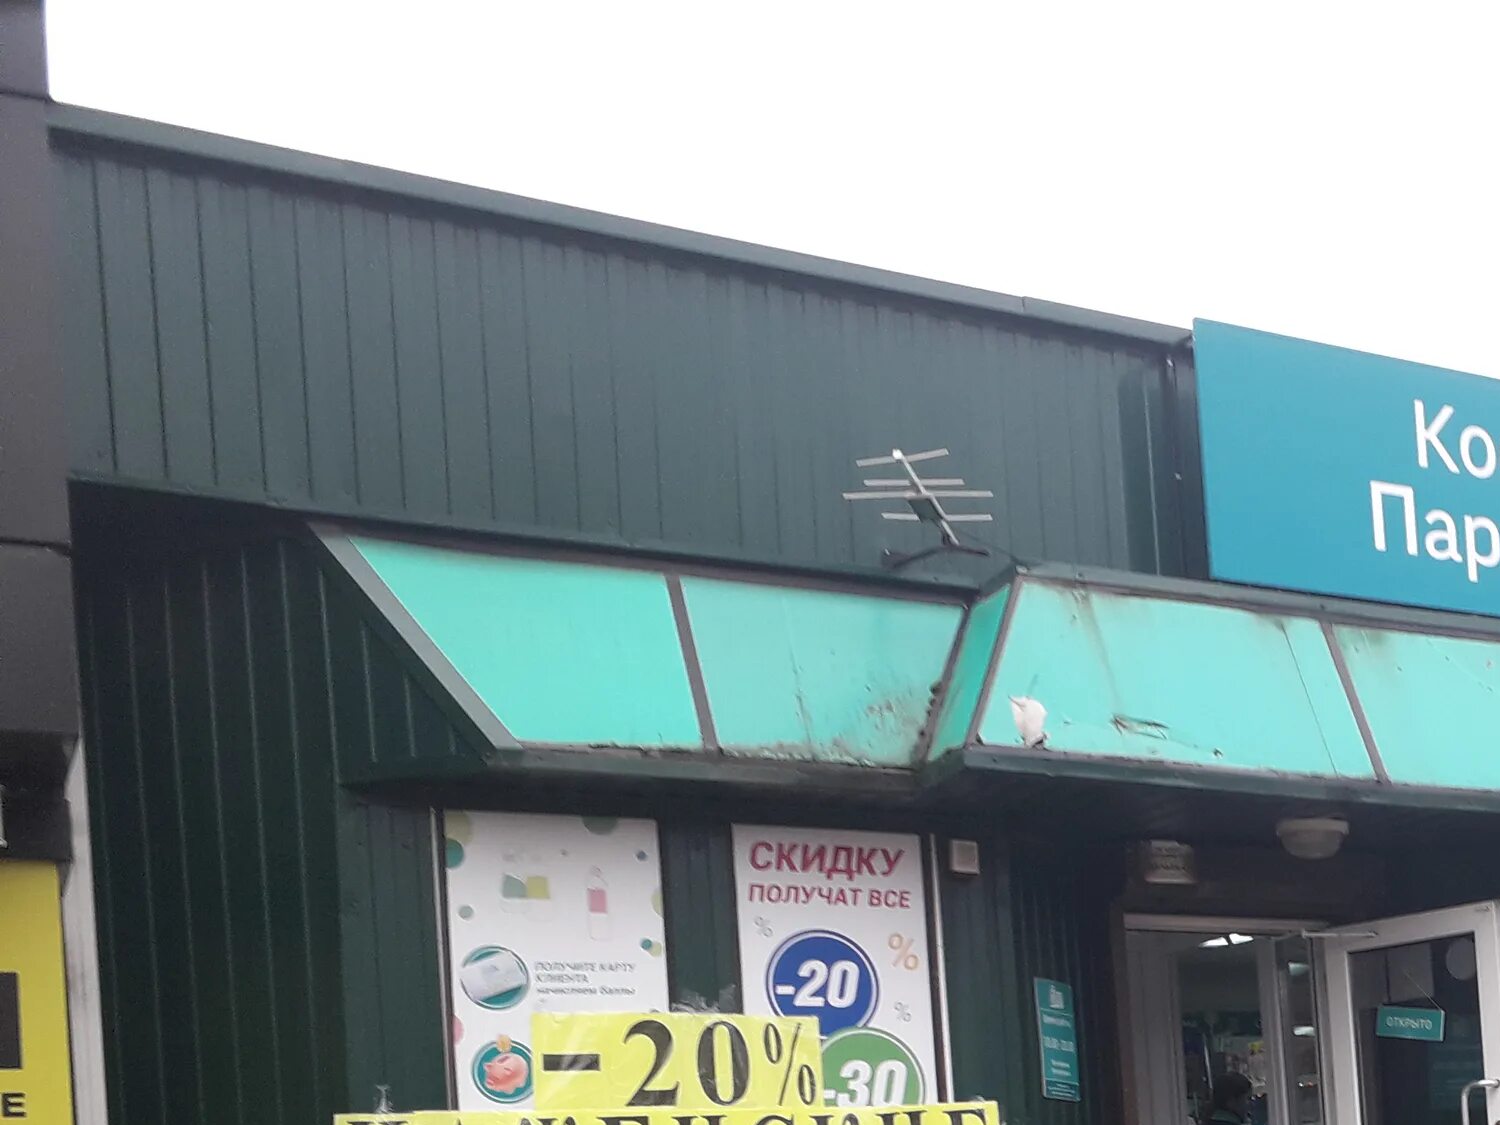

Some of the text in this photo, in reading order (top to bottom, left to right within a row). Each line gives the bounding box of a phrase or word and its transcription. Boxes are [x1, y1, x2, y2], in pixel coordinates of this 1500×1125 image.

[749, 841, 905, 882] СКИДКУ
[749, 884, 911, 909] ПОЛУЧАТ ВСЕ
[775, 959, 860, 1009] -20
[542, 1019, 817, 1108] -20%
